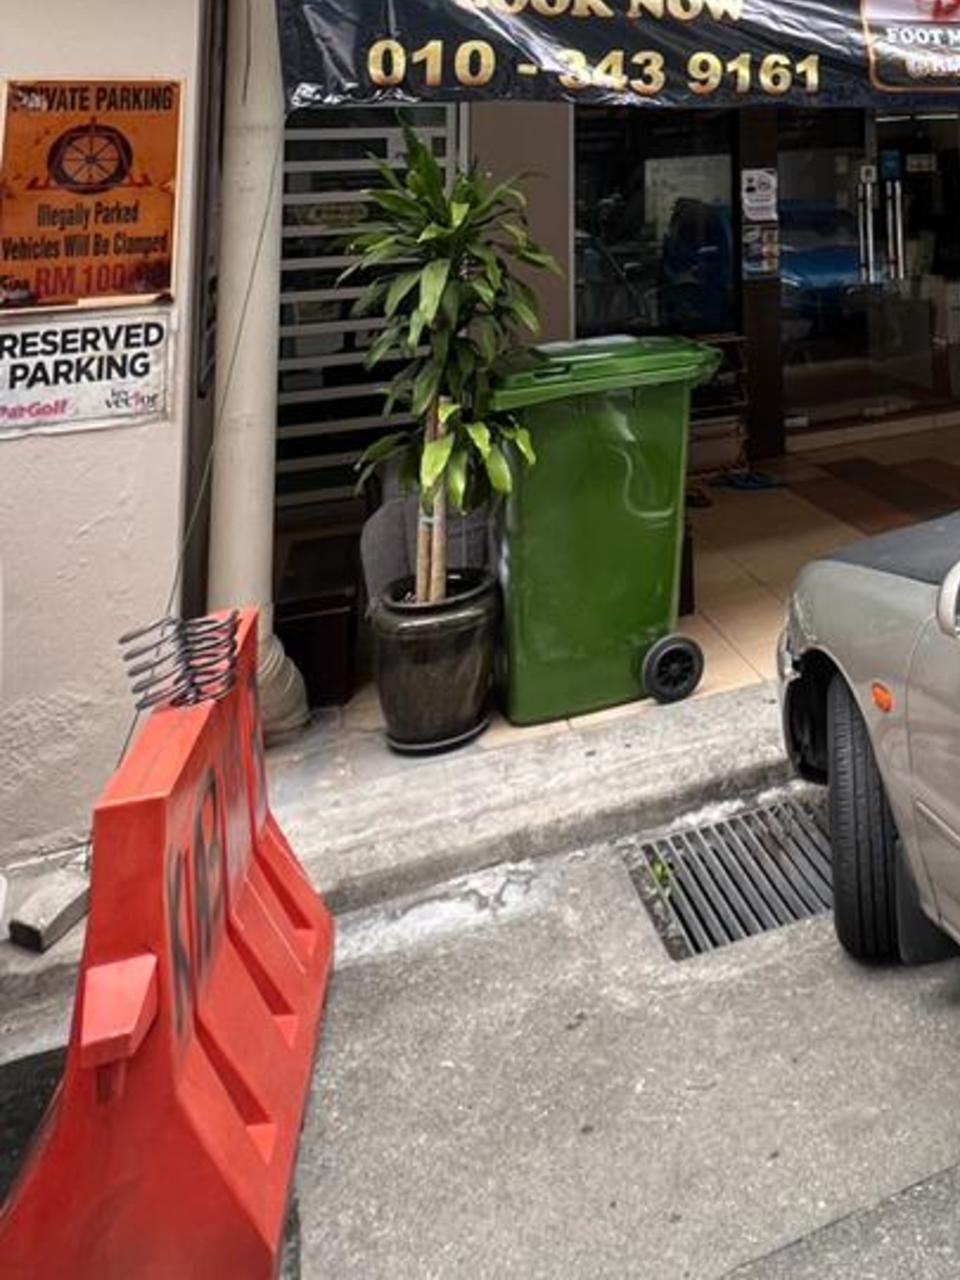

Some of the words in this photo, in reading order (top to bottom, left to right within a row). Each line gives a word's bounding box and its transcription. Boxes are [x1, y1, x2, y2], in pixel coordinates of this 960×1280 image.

[886, 27, 945, 45] FOOT
[367, 38, 496, 87] 010
[556, 48, 666, 94] 343
[687, 52, 821, 95] 9161
[95, 84, 173, 112] PARKING
[94, 199, 140, 224] Parked
[1, 236, 61, 261] Vehicles
[93, 233, 110, 256] Be
[0, 322, 165, 360] RESERVED
[9, 351, 151, 390] PARKING
